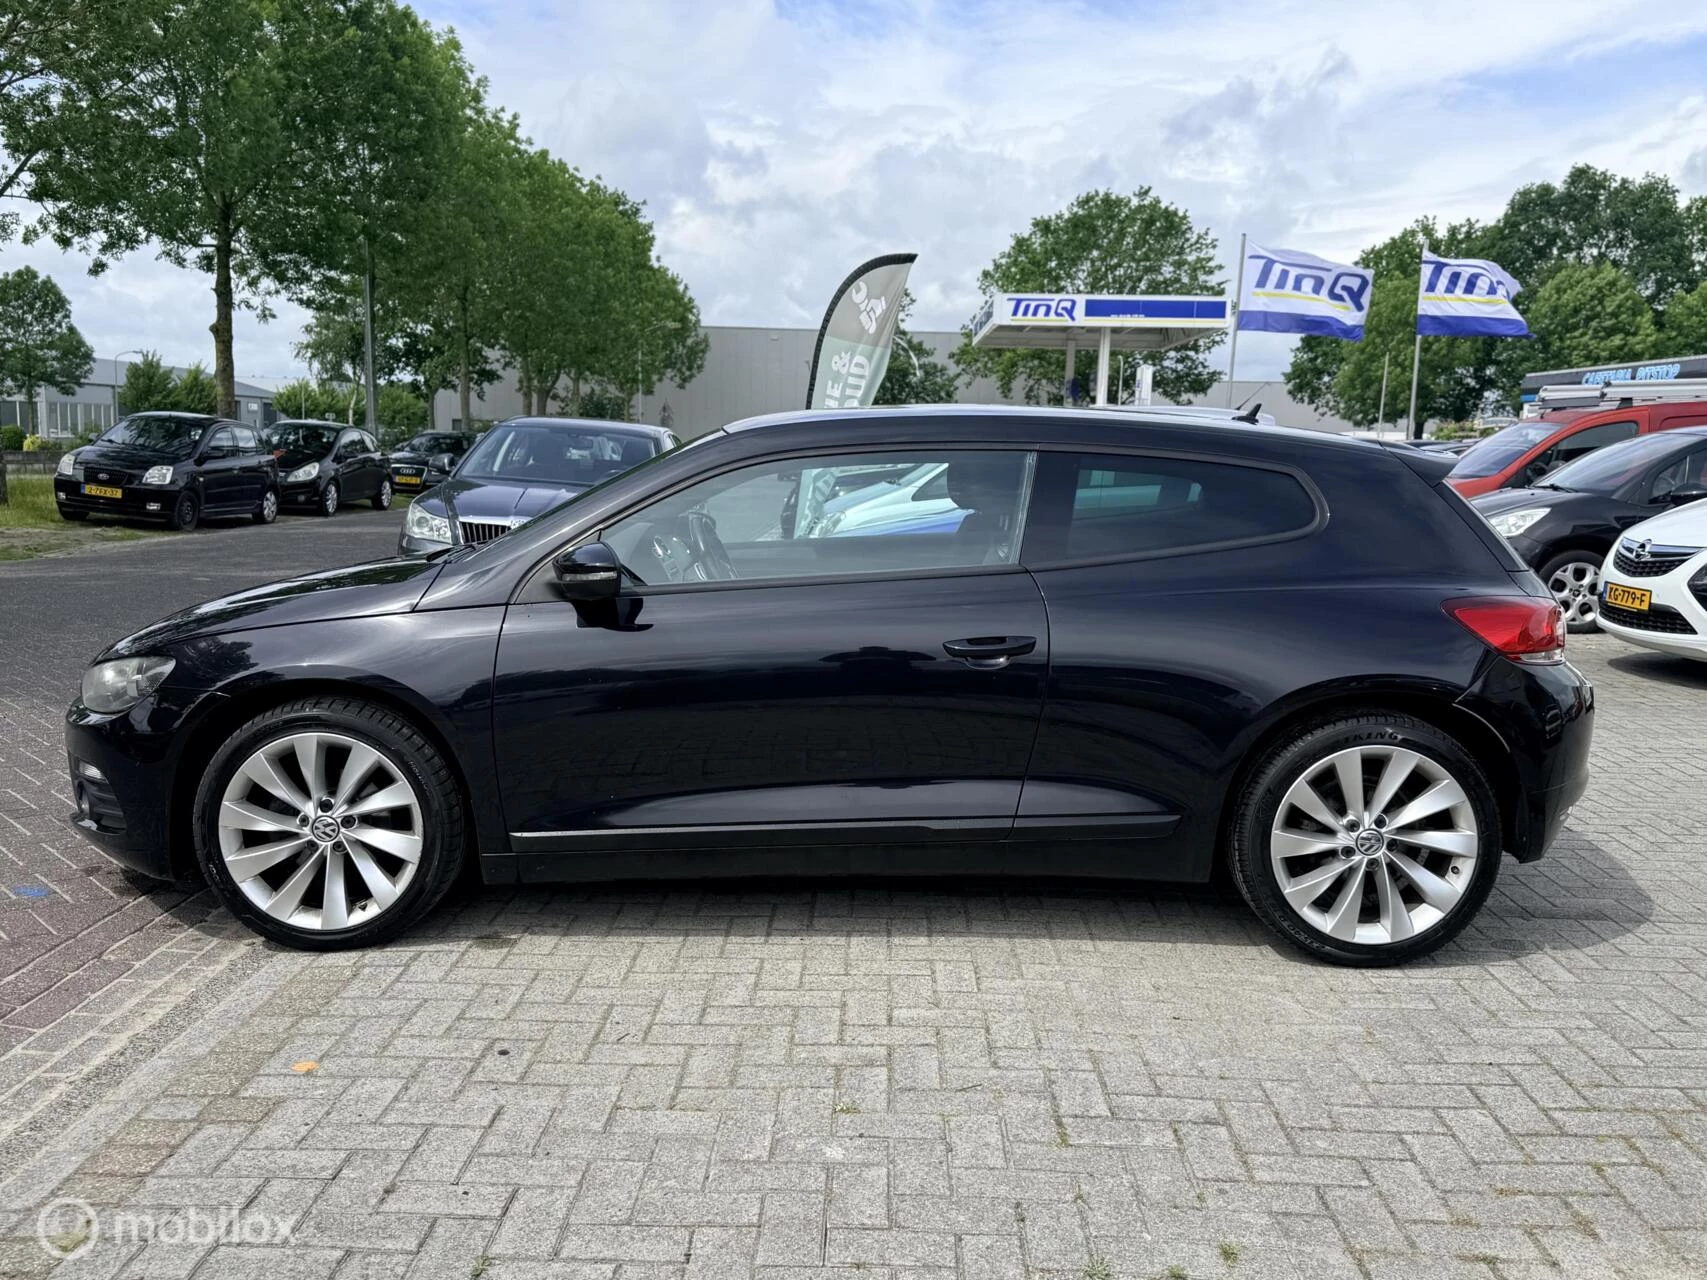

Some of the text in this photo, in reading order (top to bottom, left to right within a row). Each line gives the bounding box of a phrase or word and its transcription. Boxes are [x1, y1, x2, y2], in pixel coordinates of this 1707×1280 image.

[1248, 255, 1370, 312] TinQ
[1007, 298, 1077, 321] TinQ
[1608, 586, 1647, 607] KG-779-F
